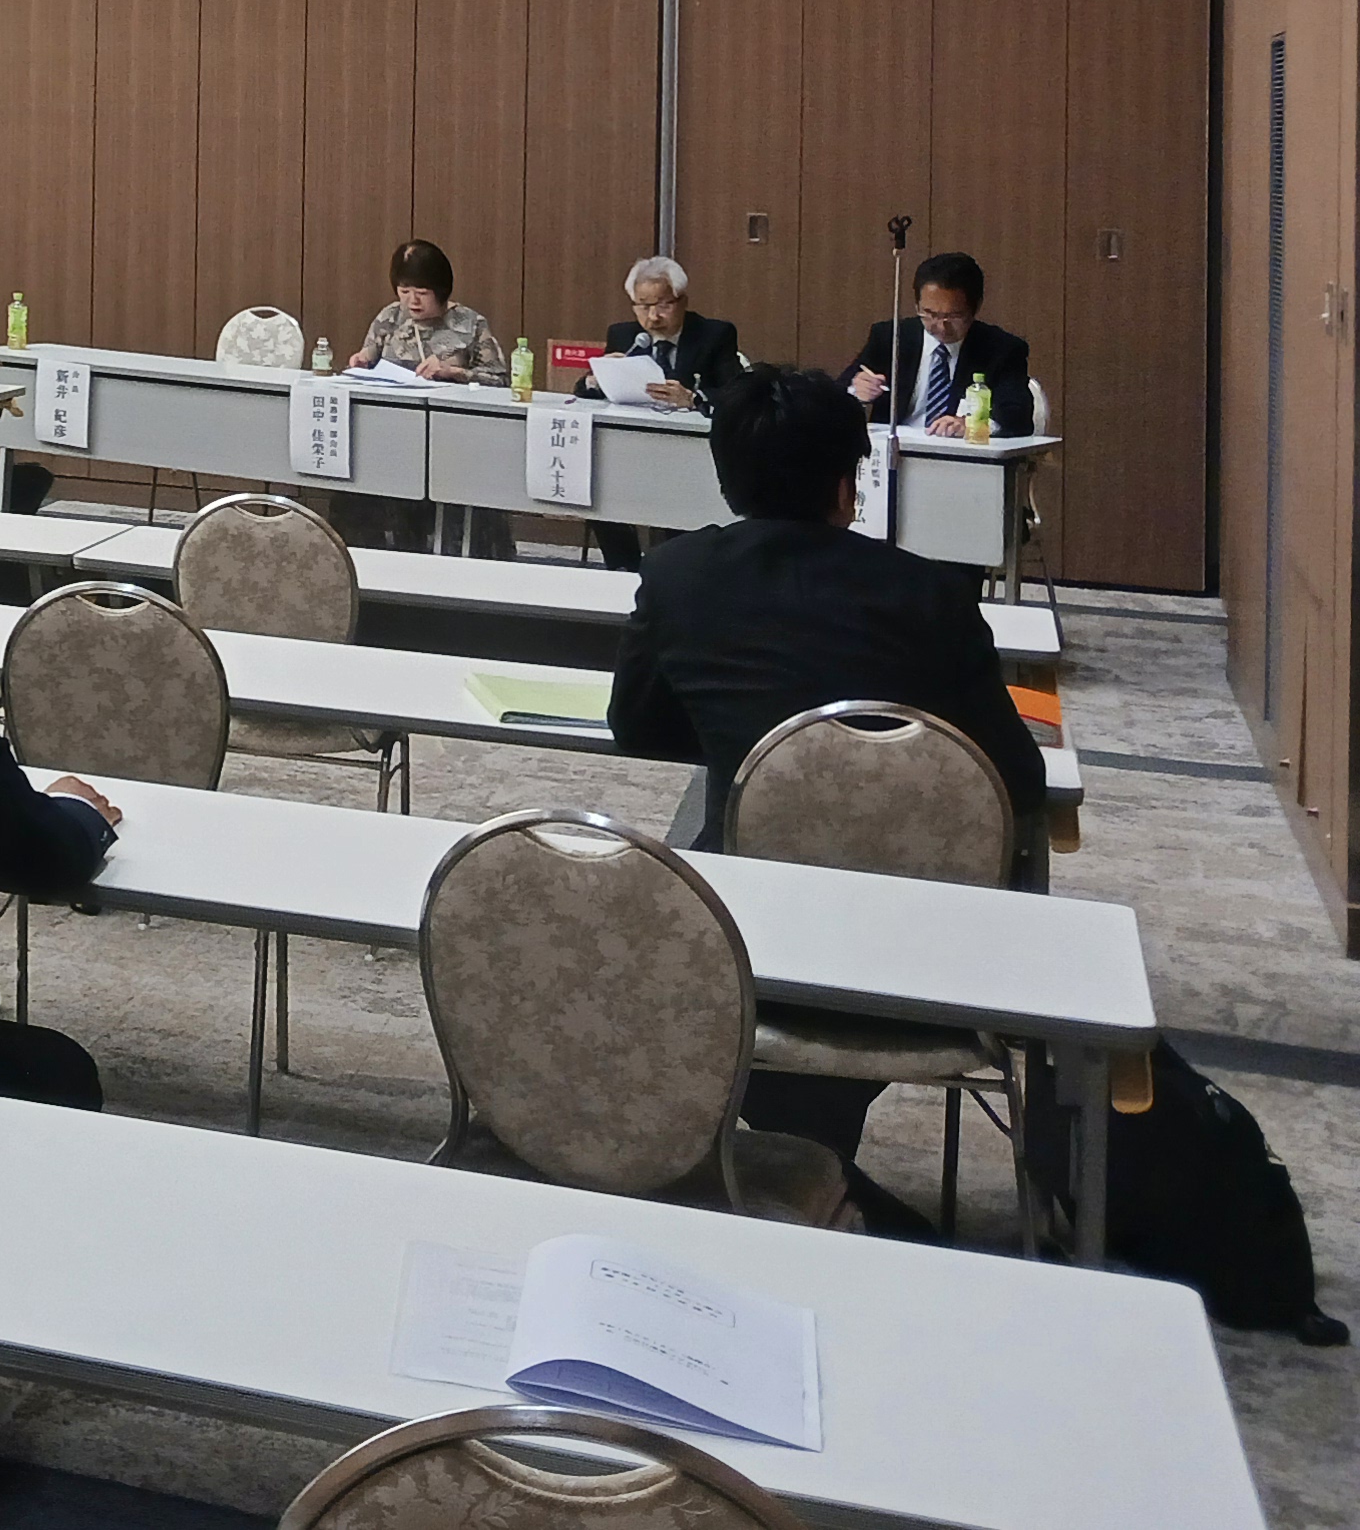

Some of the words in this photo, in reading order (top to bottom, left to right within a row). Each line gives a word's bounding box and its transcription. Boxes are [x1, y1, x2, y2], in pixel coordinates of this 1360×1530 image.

[55, 368, 69, 399] 新井
[53, 408, 68, 438] 紀彦
[312, 395, 325, 422] 田中
[550, 455, 566, 498] 八十夫
